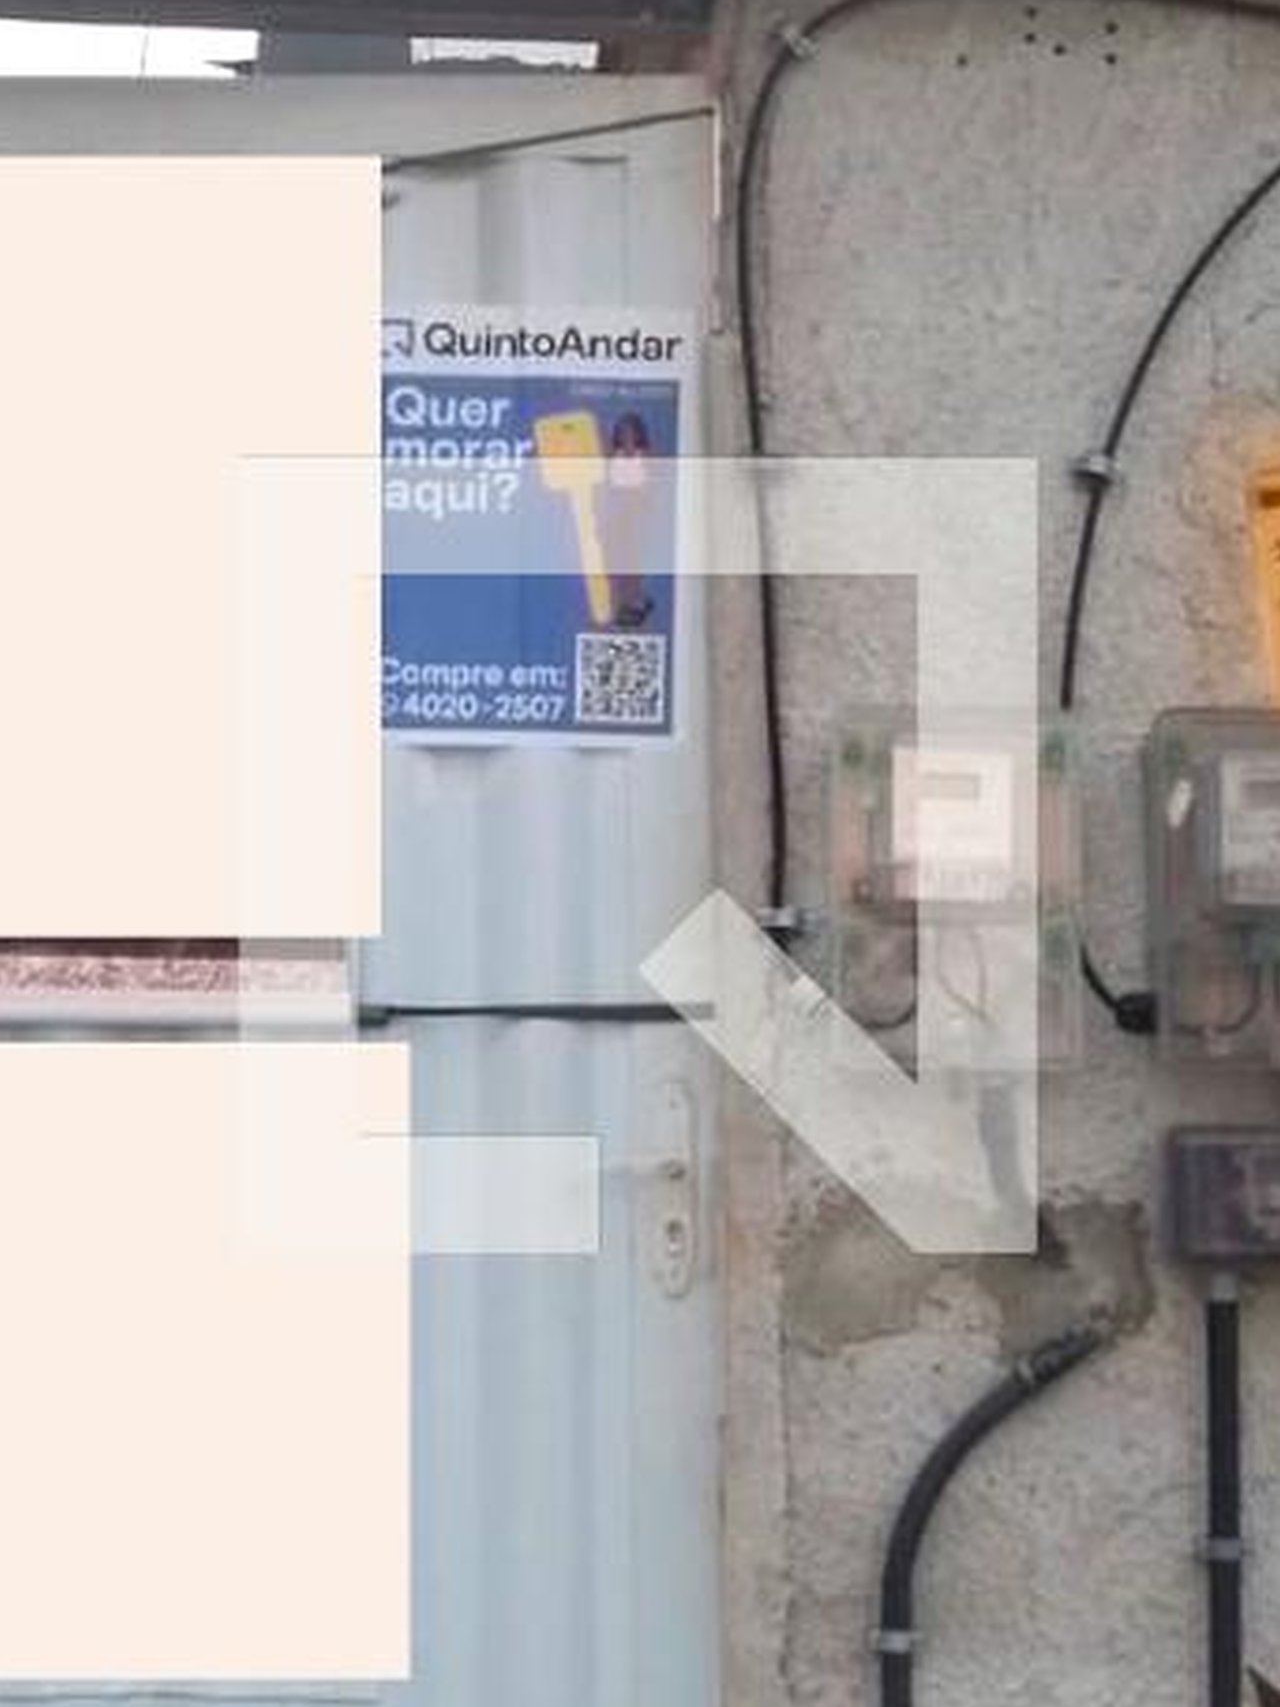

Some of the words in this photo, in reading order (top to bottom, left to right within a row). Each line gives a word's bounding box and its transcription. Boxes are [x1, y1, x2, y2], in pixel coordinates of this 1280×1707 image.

[422, 321, 682, 362] QuintoAndar
[386, 385, 511, 428] Quer
[385, 437, 533, 470] morar
[384, 471, 519, 521] aqui?
[383, 657, 504, 692] Compre
[509, 663, 568, 689] em:
[402, 692, 565, 721] 4020-2507
